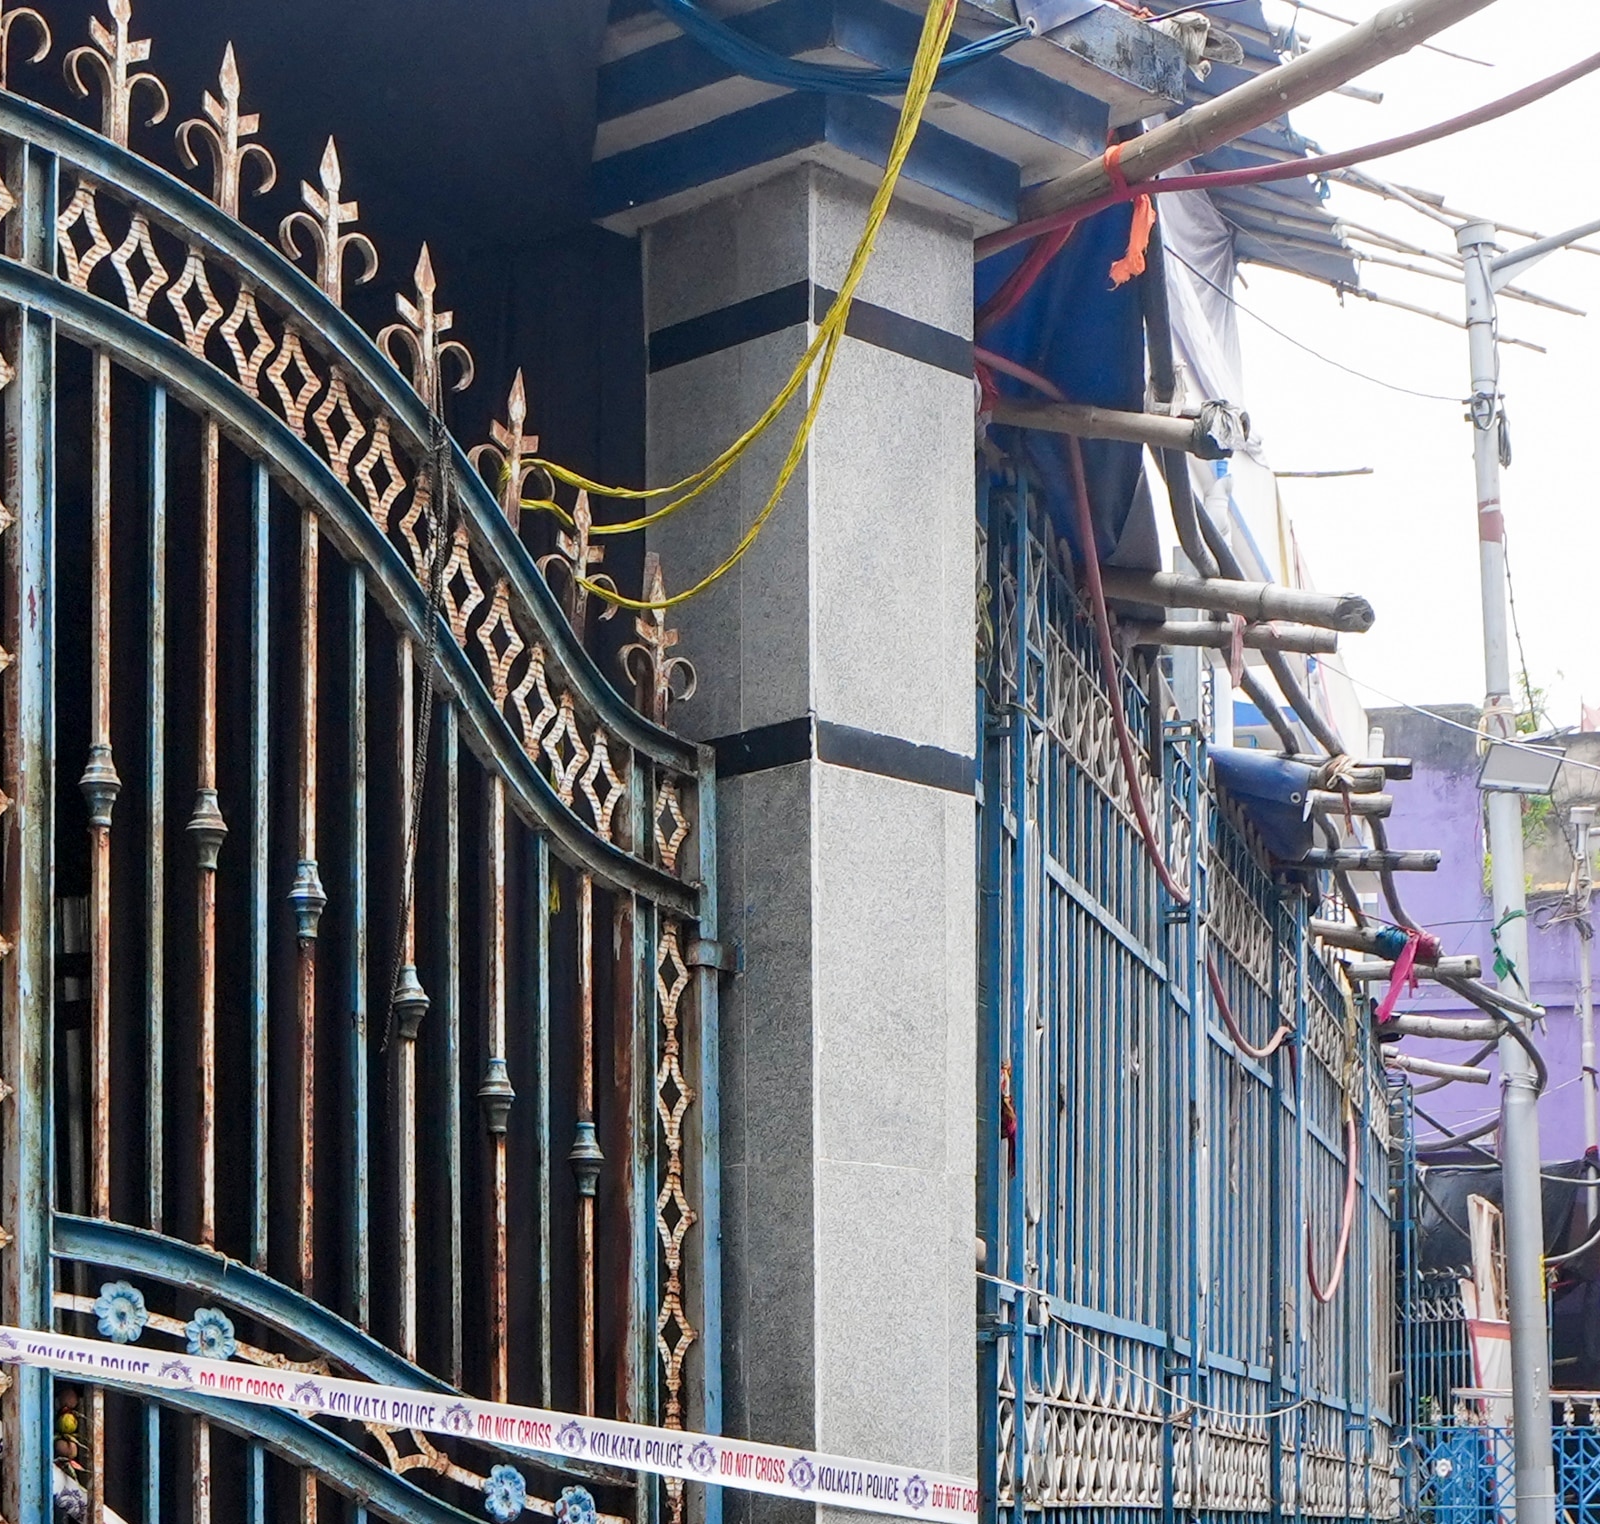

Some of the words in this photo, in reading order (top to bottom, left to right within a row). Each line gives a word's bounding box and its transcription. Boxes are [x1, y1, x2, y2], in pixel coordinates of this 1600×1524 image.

[328, 1391, 391, 1422] KOLKATA
[392, 1401, 436, 1429] POLICE
[477, 1413, 492, 1438] DO
[493, 1416, 516, 1443] NOT
[517, 1420, 552, 1449] CROSS
[589, 1430, 642, 1461] KOLKATA
[645, 1440, 684, 1469] POLICE
[720, 1451, 733, 1475] DO
[735, 1453, 754, 1479] NOT
[755, 1456, 785, 1485] CROSS
[818, 1465, 863, 1496] KOLKATA
[865, 1473, 900, 1502] POLICE
[931, 1483, 944, 1508] DO
[944, 1485, 962, 1511] NOT
[962, 1488, 979, 1513] CRO
